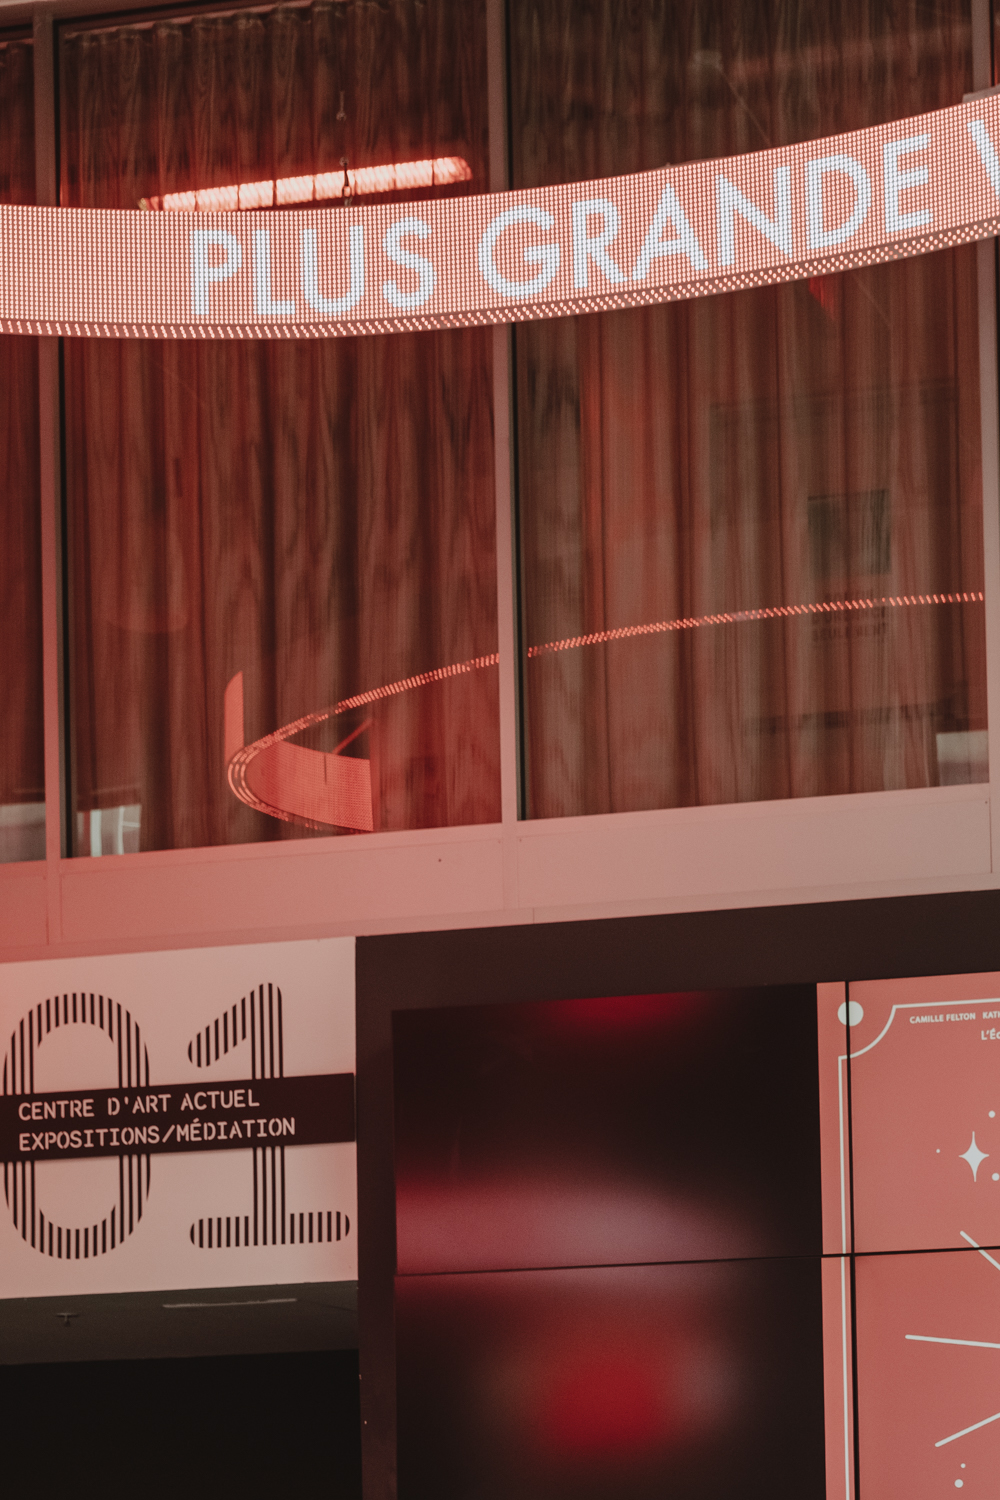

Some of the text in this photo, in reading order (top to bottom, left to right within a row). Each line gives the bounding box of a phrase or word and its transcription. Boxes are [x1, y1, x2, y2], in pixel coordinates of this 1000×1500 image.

[191, 217, 437, 316] PLUS
[478, 133, 934, 299] GRANDE
[910, 1014, 944, 1024] CAMILLE
[946, 1012, 976, 1022] FELTON
[18, 1088, 260, 1121] CENTRE D'ART ACTUEL
[18, 1117, 296, 1152] EXPOSITIONS/MÉDIATION
